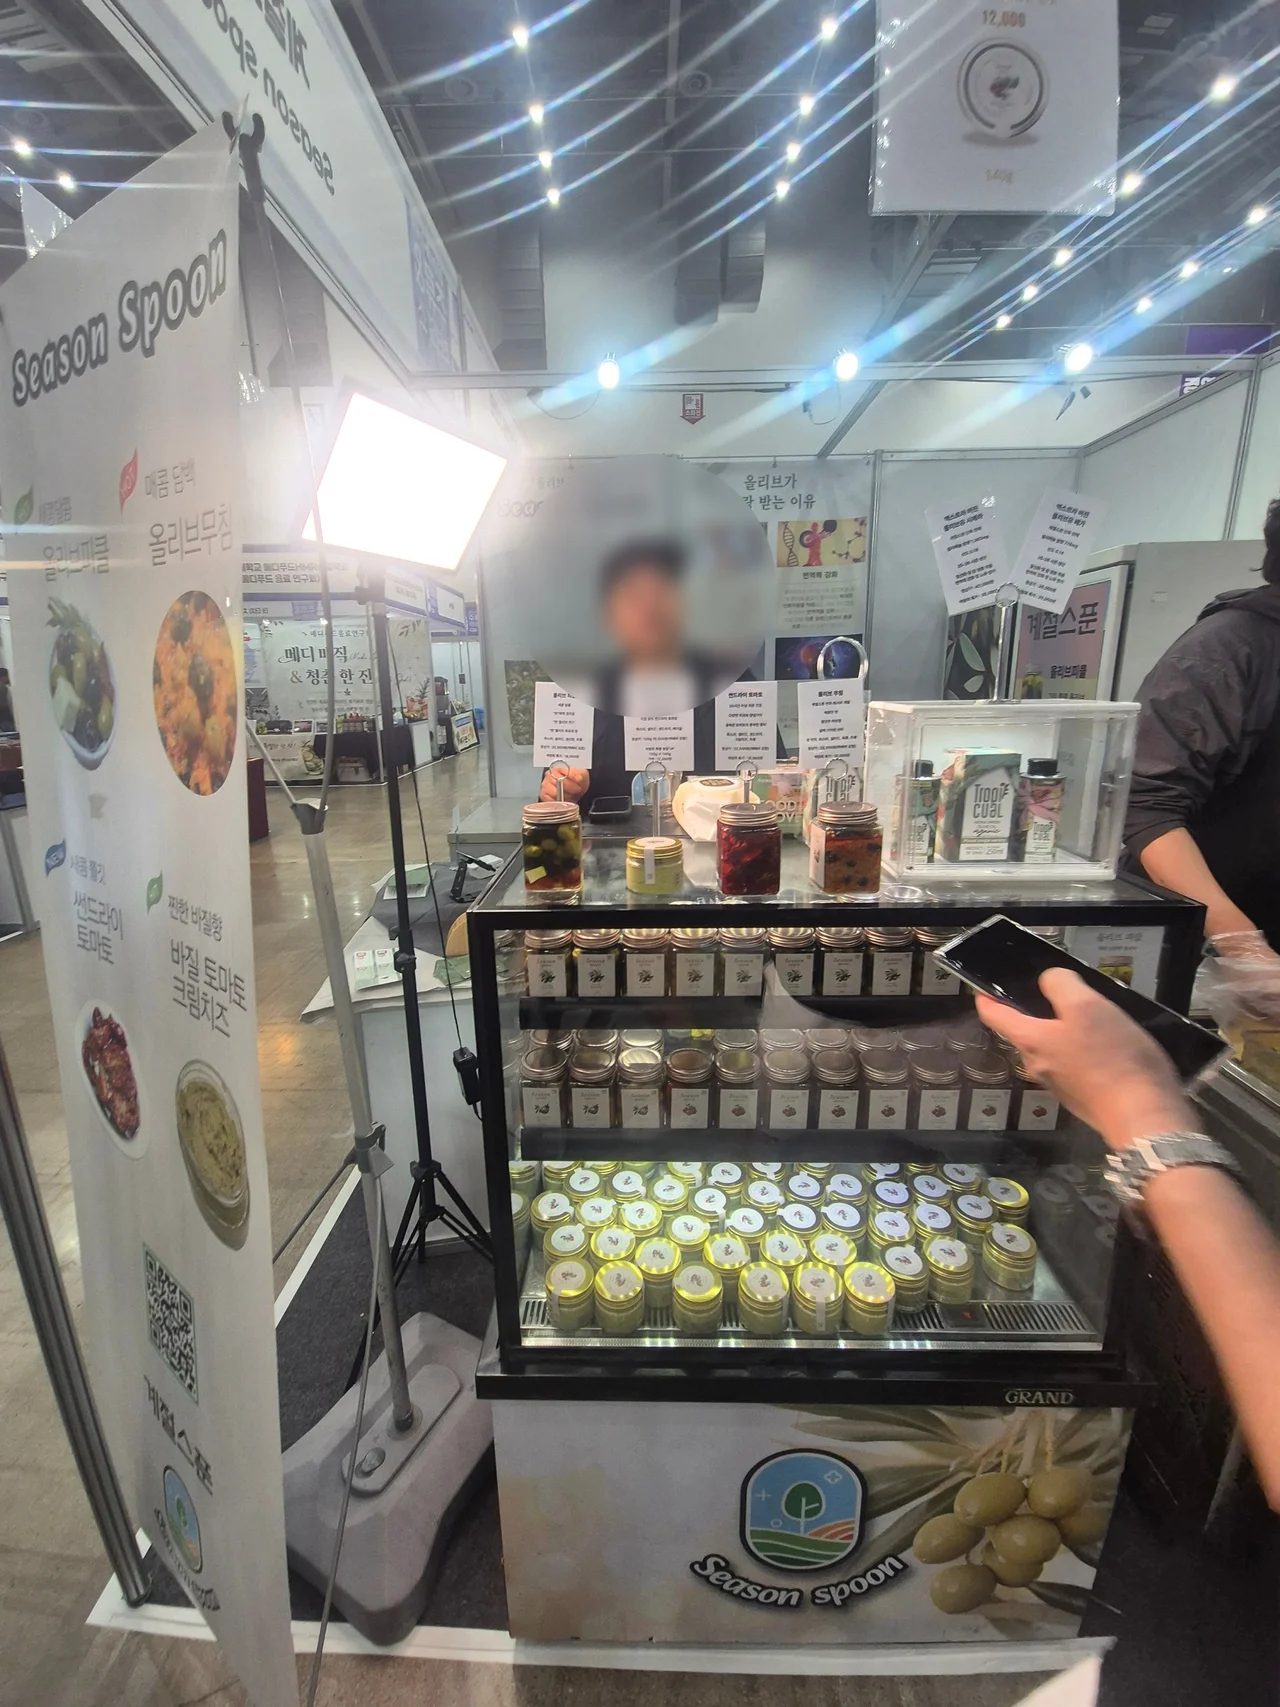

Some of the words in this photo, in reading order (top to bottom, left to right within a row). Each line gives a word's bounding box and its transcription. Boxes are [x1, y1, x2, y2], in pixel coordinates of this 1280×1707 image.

[982, 10, 1026, 28] 12,000
[13, 313, 108, 406] Season
[119, 229, 227, 358] Spoon
[744, 473, 798, 491] 올리브가
[759, 495, 785, 510] 받는
[791, 494, 817, 509] 이유
[149, 503, 233, 566] 올리브무침
[1027, 602, 1099, 640] 계절스푼
[339, 668, 354, 685] 한
[77, 924, 114, 965] 토마토
[171, 939, 199, 984] 바질
[203, 956, 247, 1012] 토마토
[173, 975, 231, 1038] 크림치즈
[1005, 1390, 1074, 1406] GRAND
[691, 1554, 803, 1608] Season
[811, 1554, 908, 1606] spoon
